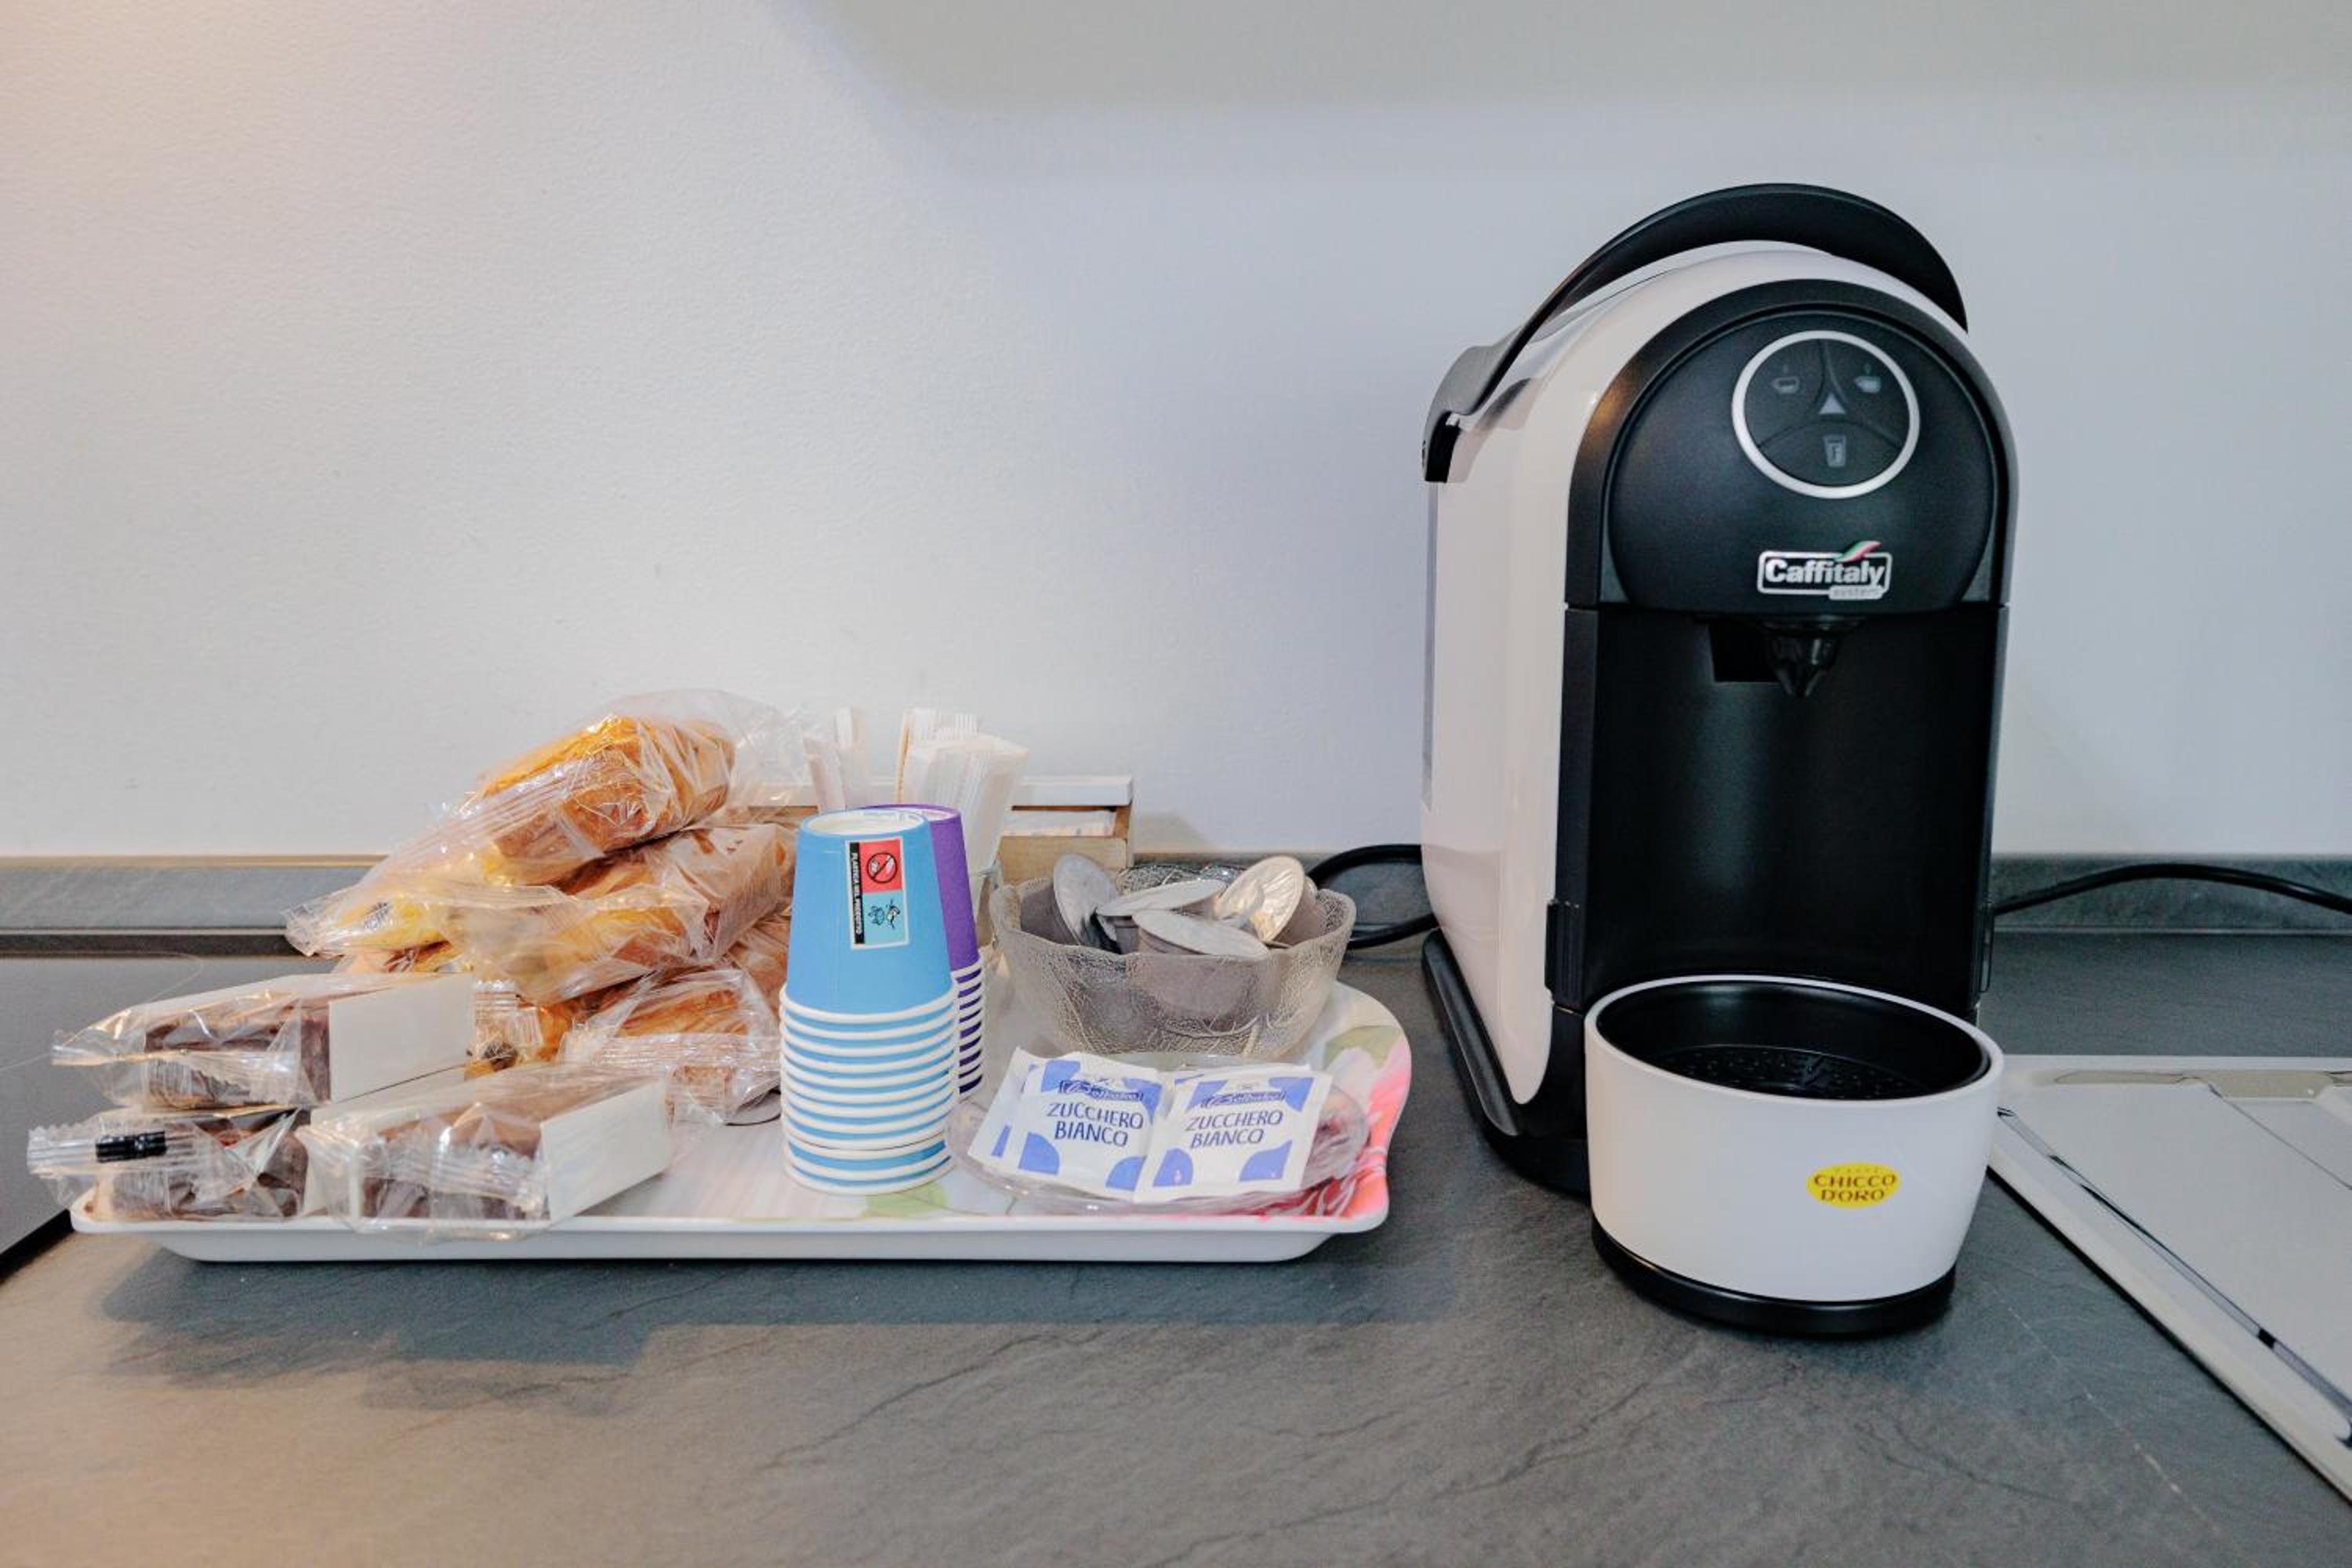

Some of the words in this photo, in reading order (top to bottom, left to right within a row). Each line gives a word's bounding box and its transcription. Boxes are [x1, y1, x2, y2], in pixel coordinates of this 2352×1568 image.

[1766, 559, 1885, 587] Caffitaly
[1047, 1102, 1144, 1130] ZUCCHERO
[1185, 1109, 1283, 1131] ZUCCHERO
[1054, 1121, 1129, 1147] BIANCO
[1190, 1128, 1265, 1149] BIANCO
[1813, 1174, 1896, 1188] CHICCO
